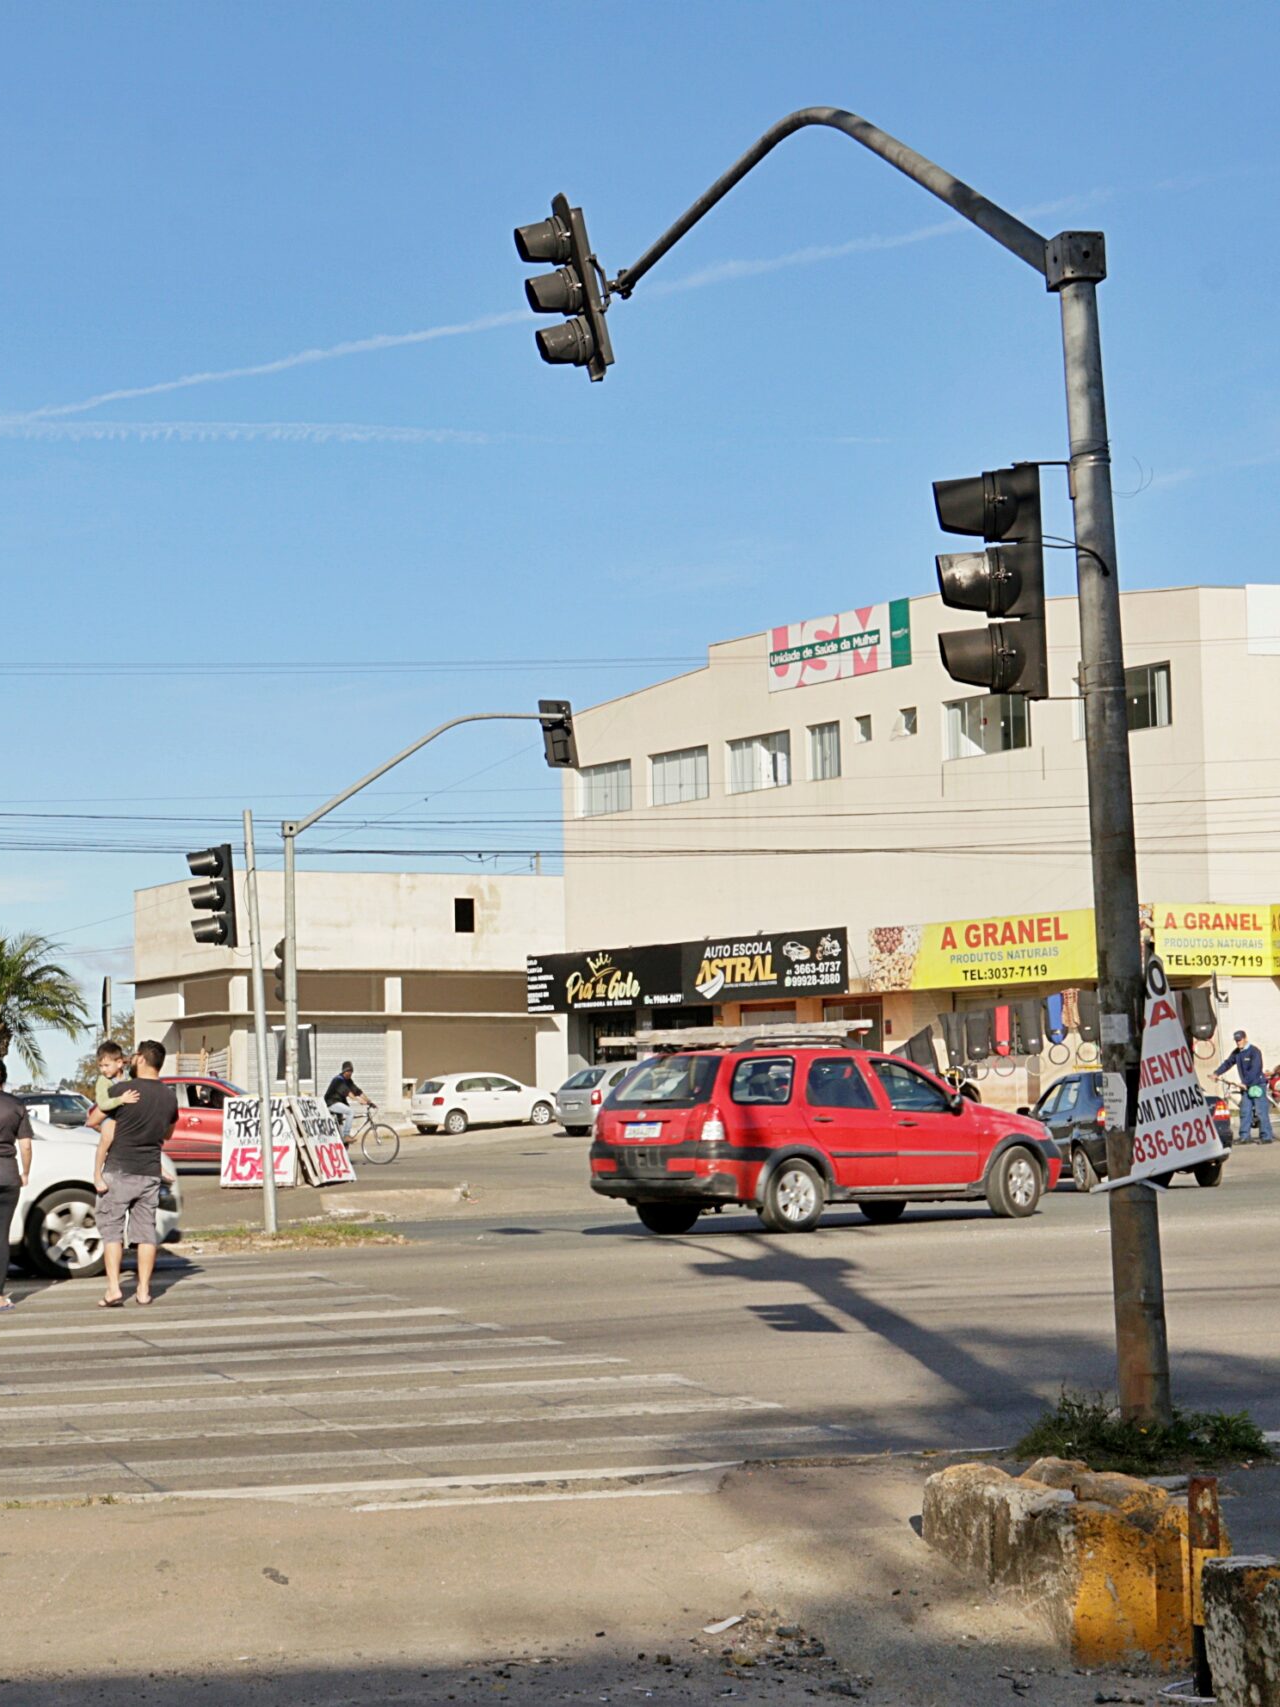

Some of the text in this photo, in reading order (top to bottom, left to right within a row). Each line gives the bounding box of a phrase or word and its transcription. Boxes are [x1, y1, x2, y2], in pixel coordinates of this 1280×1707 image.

[770, 633, 879, 665] Unidade de Saúde da Mulher
[1164, 912, 1177, 930] A
[1183, 912, 1263, 932] GRANEL
[940, 916, 1069, 950] A GRANEL
[704, 941, 772, 959] AUTO ESCOLA
[1164, 938, 1216, 949] PRODUTOS
[1217, 939, 1263, 949] NATURAIS
[950, 946, 1060, 964] PRODUTOS NATURAIS
[1166, 954, 1263, 967] TEL:3037-7119
[695, 955, 778, 986] ASTRAL
[794, 961, 841, 976] 3663-0737
[962, 964, 1048, 981] TEL:3037-7119
[1147, 960, 1167, 997] O
[608, 970, 641, 1000] Gole
[791, 973, 841, 988] 99928-2880
[1143, 999, 1177, 1027] A
[1156, 1083, 1205, 1119] DÍVIDAS
[235, 1119, 284, 1138] TRIO
[1131, 1113, 1217, 1165] 836-6281
